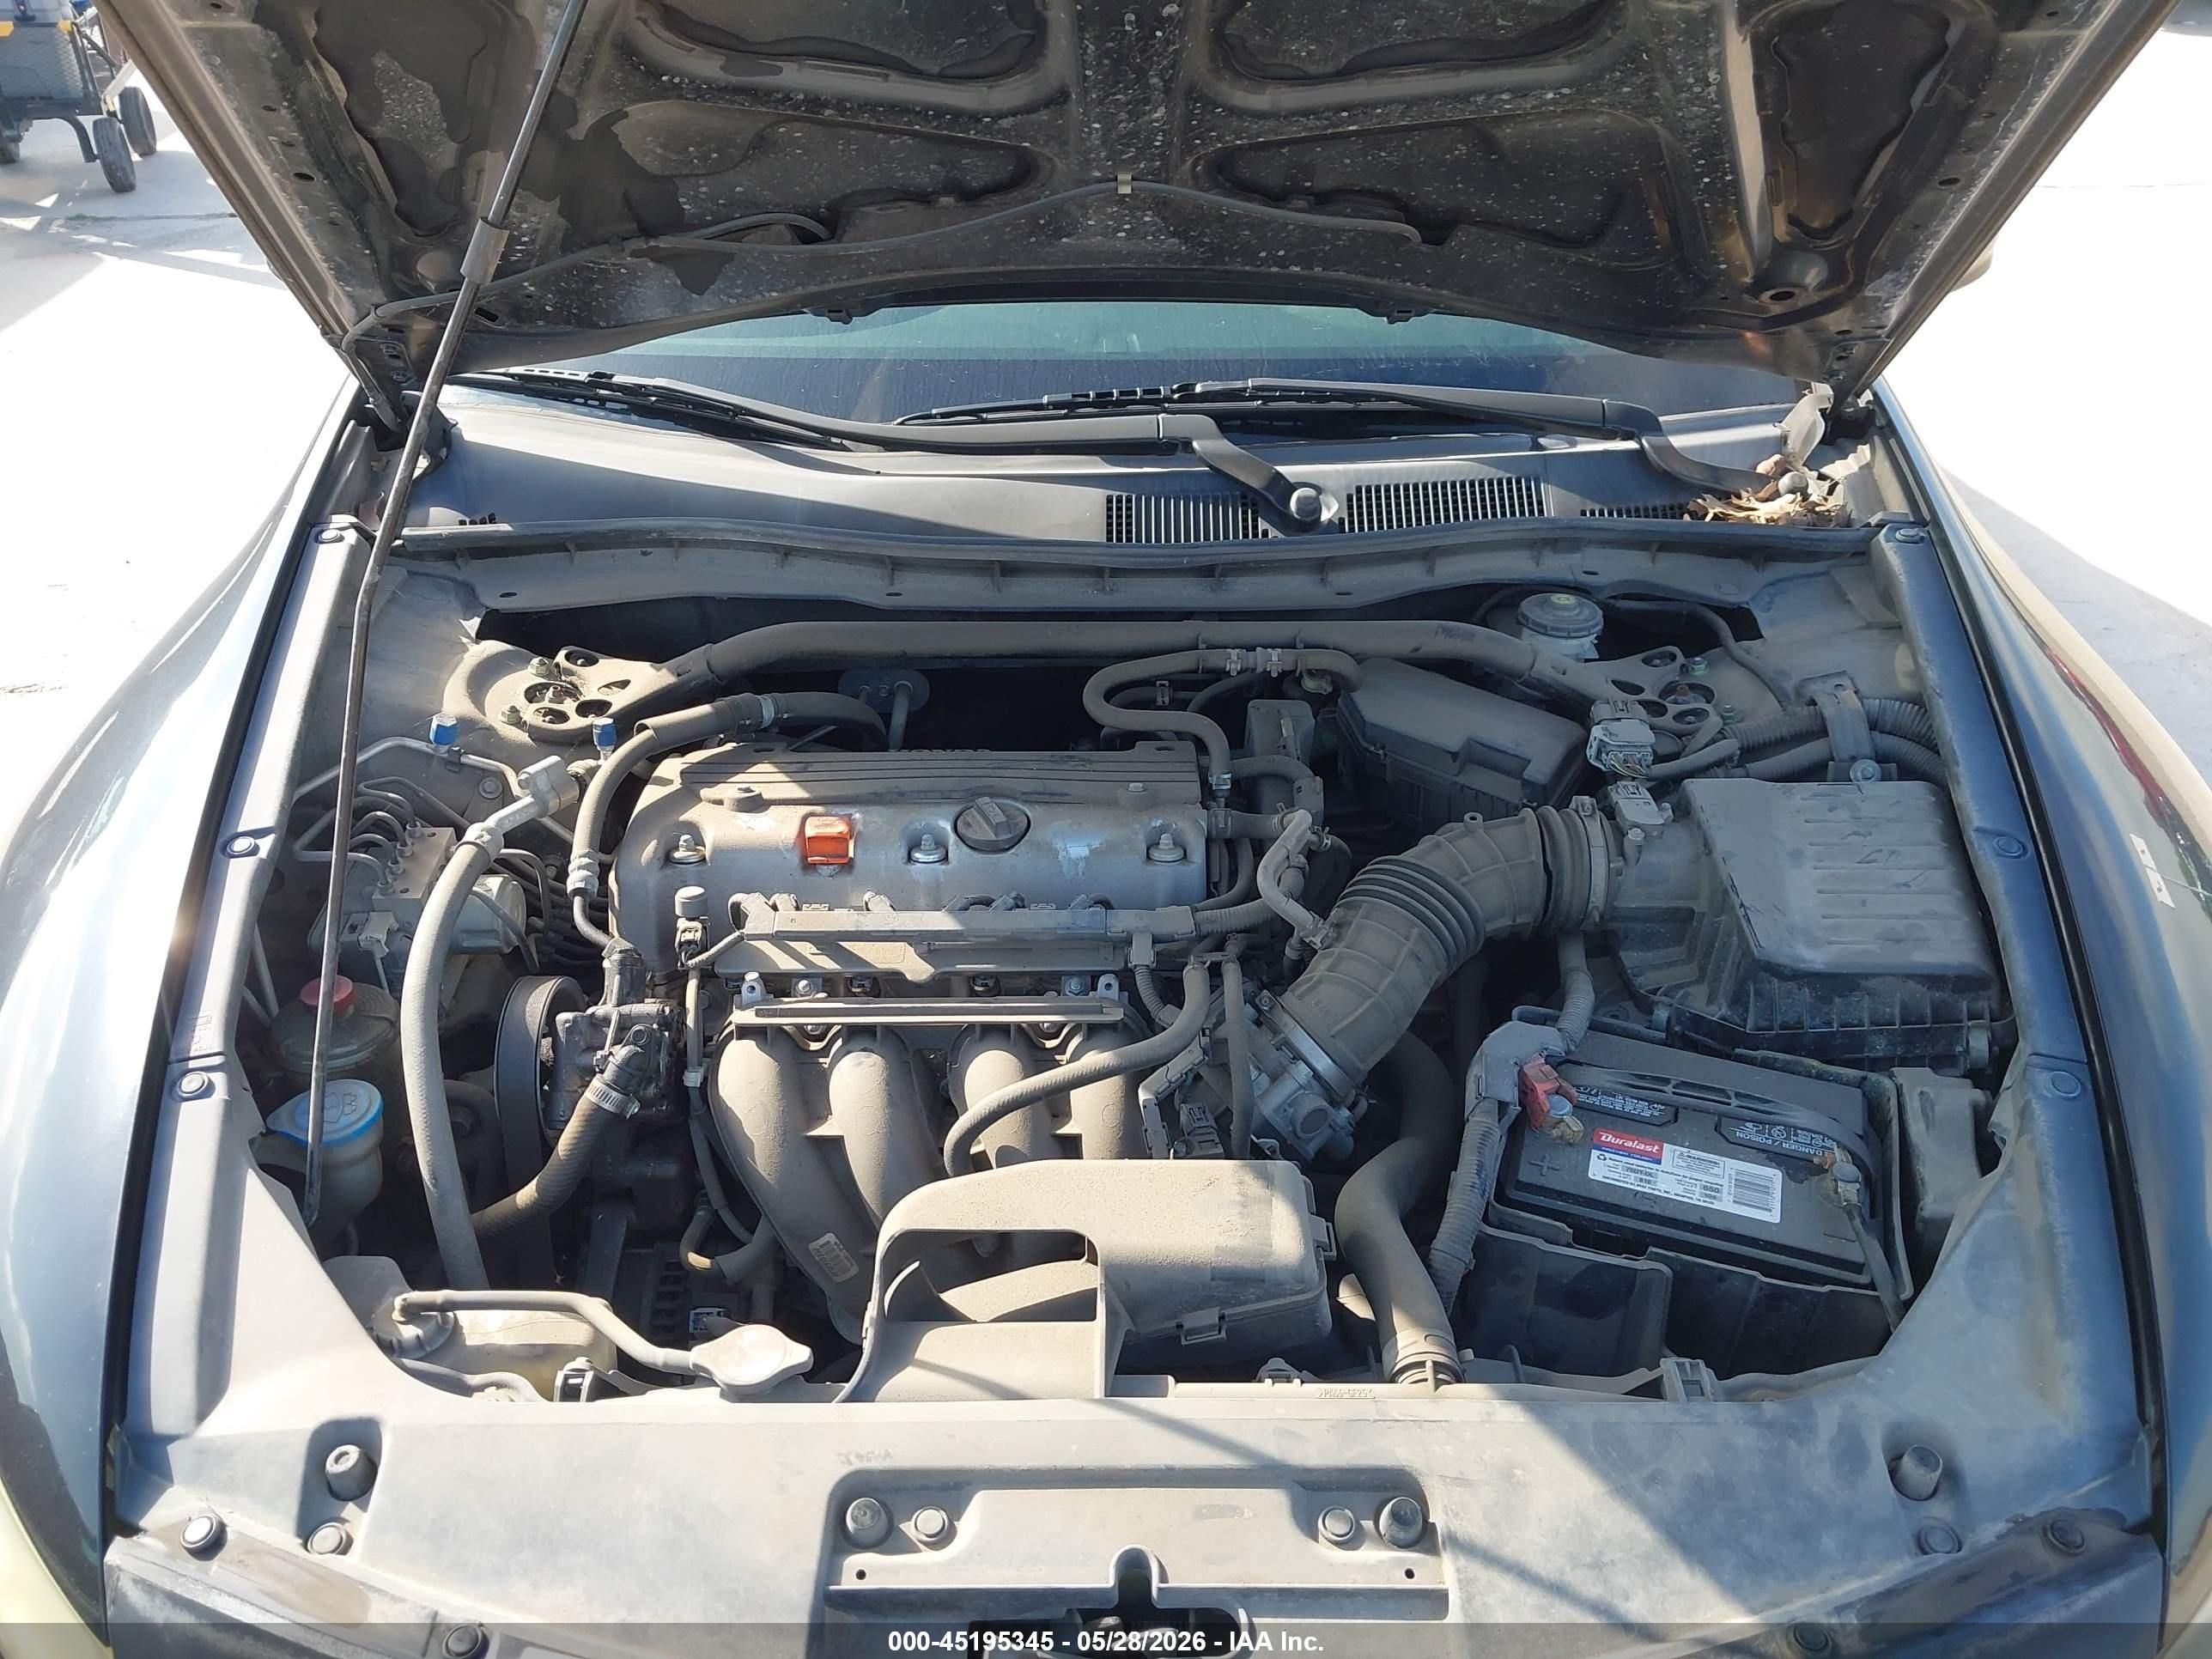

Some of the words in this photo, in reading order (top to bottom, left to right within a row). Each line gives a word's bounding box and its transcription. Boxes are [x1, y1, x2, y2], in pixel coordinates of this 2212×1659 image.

[1599, 1132, 1661, 1153] Duralast
[1735, 1131, 1772, 1145] POISON
[1783, 1142, 1823, 1156] DANGER
[1703, 1184, 1720, 1194] 650
